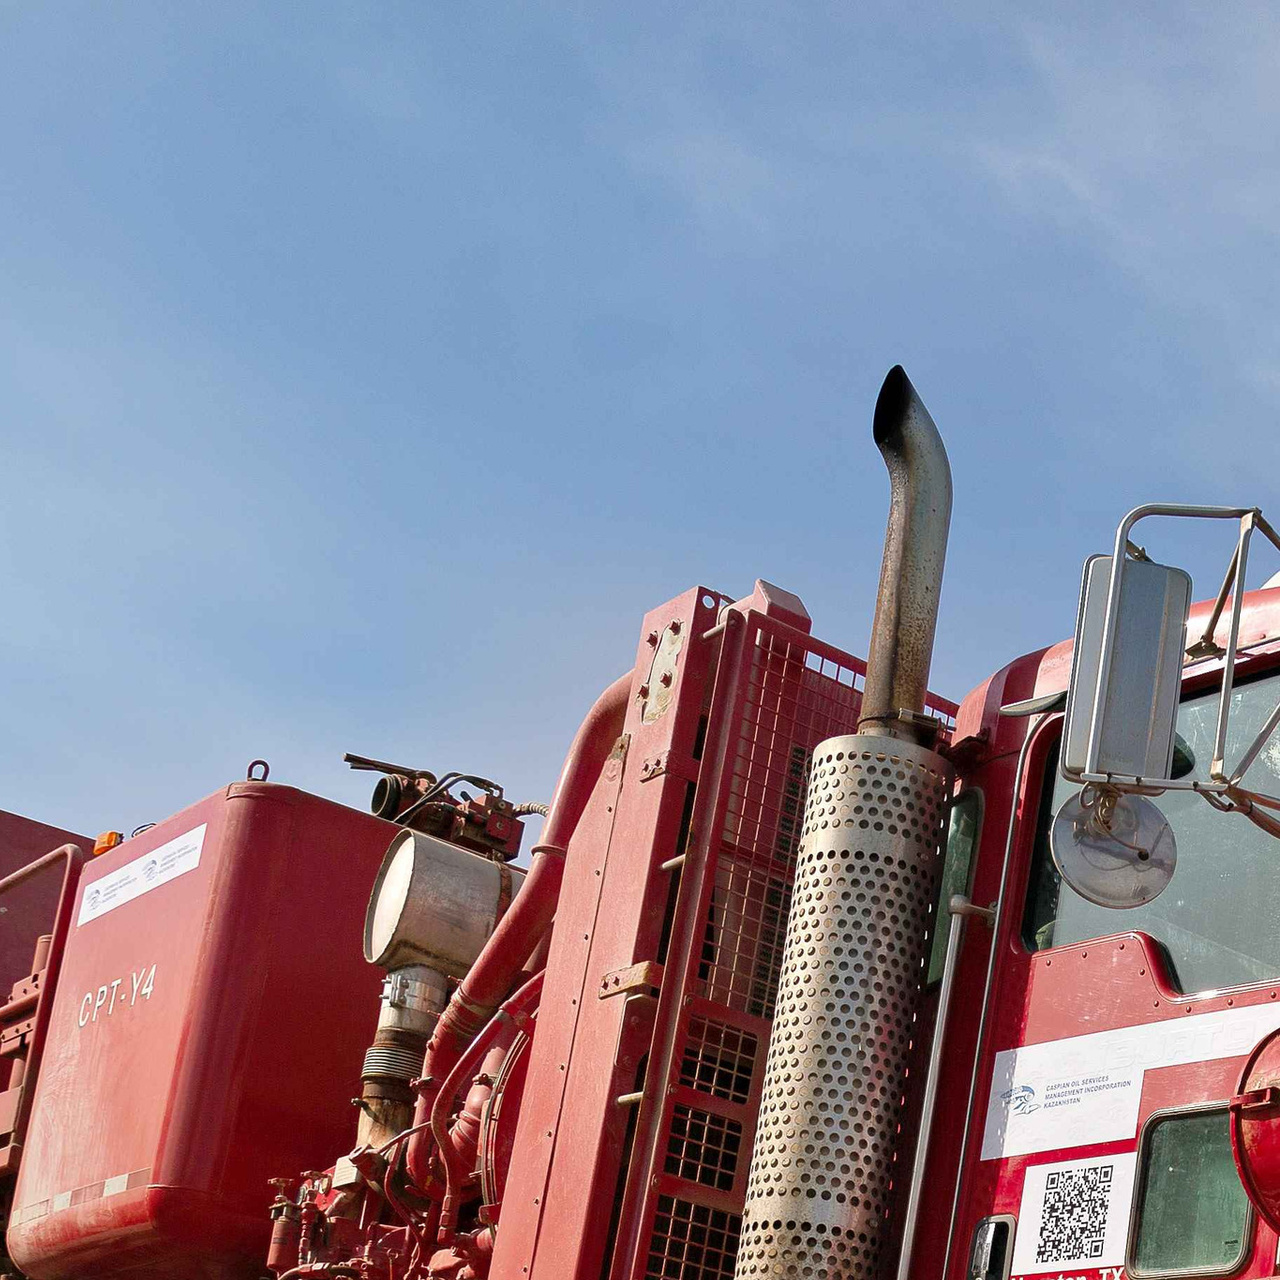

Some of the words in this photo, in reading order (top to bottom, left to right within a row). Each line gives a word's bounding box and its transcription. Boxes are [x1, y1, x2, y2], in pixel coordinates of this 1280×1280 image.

[1045, 1088, 1084, 1100] MANAGEMENT
[1085, 1080, 1131, 1094] INCORPORATION
[1046, 1082, 1070, 1092] CASPIAN
[1082, 1075, 1109, 1086] SERVICES
[1043, 1097, 1081, 1109] KAZAKHSTAN
